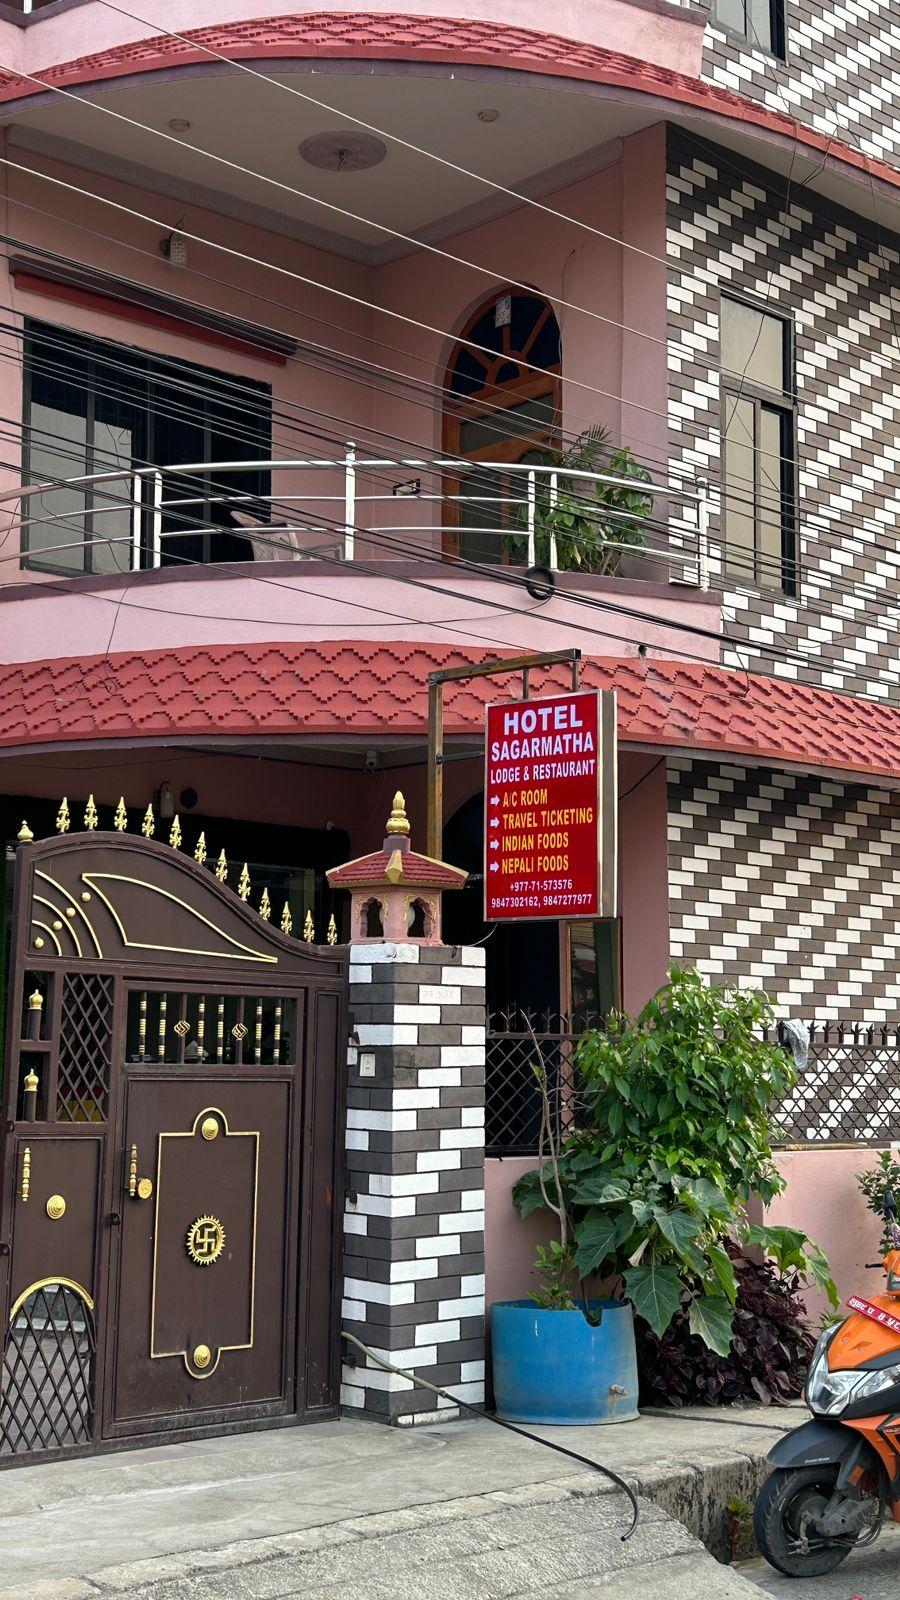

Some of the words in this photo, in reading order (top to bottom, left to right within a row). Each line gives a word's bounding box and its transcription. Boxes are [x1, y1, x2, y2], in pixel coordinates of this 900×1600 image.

[504, 704, 583, 736] HOTEL
[491, 731, 594, 762] SAGARMATHA
[490, 767, 520, 785] LODGE
[523, 766, 530, 781] &
[533, 759, 596, 780] RESTAURANT
[503, 791, 518, 808] A/C
[520, 788, 548, 806] ROOM
[502, 812, 538, 830] TRAVEL
[541, 807, 593, 827] TICKETING
[502, 834, 534, 852] INDIAN
[537, 832, 569, 850] FOODS
[501, 857, 534, 875] NEPALI
[537, 855, 569, 872] FOODS
[510, 879, 573, 892] +977-71-573576
[491, 896, 541, 908] 9847302162,
[543, 893, 593, 906] 9847277977
